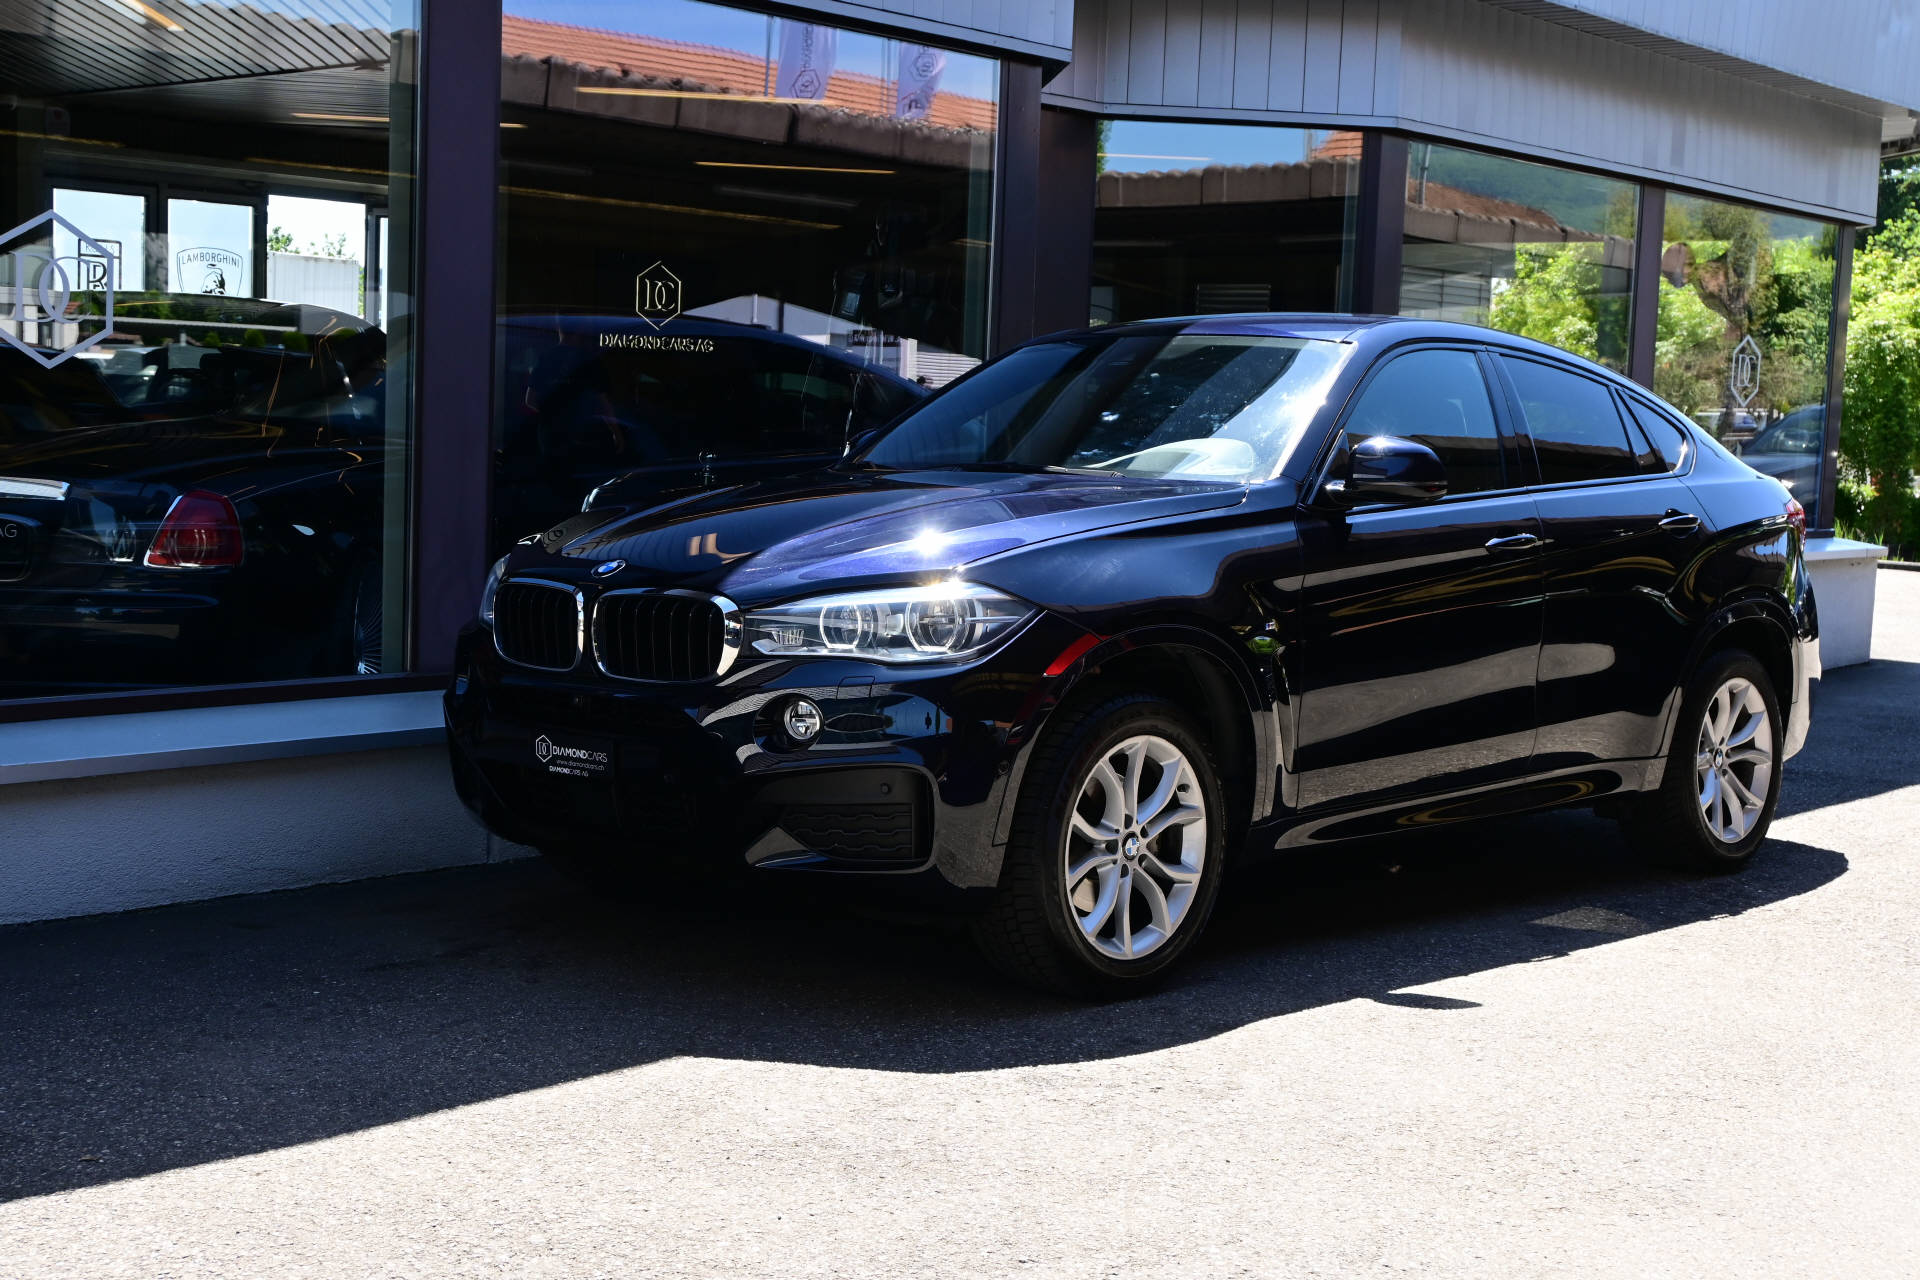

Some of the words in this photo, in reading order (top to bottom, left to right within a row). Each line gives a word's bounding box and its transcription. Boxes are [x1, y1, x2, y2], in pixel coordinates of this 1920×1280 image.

[181, 251, 240, 268] LAMBORGHINI
[552, 745, 608, 763] DIAMONDCARS
[549, 765, 581, 776] DIAMONDCARS
